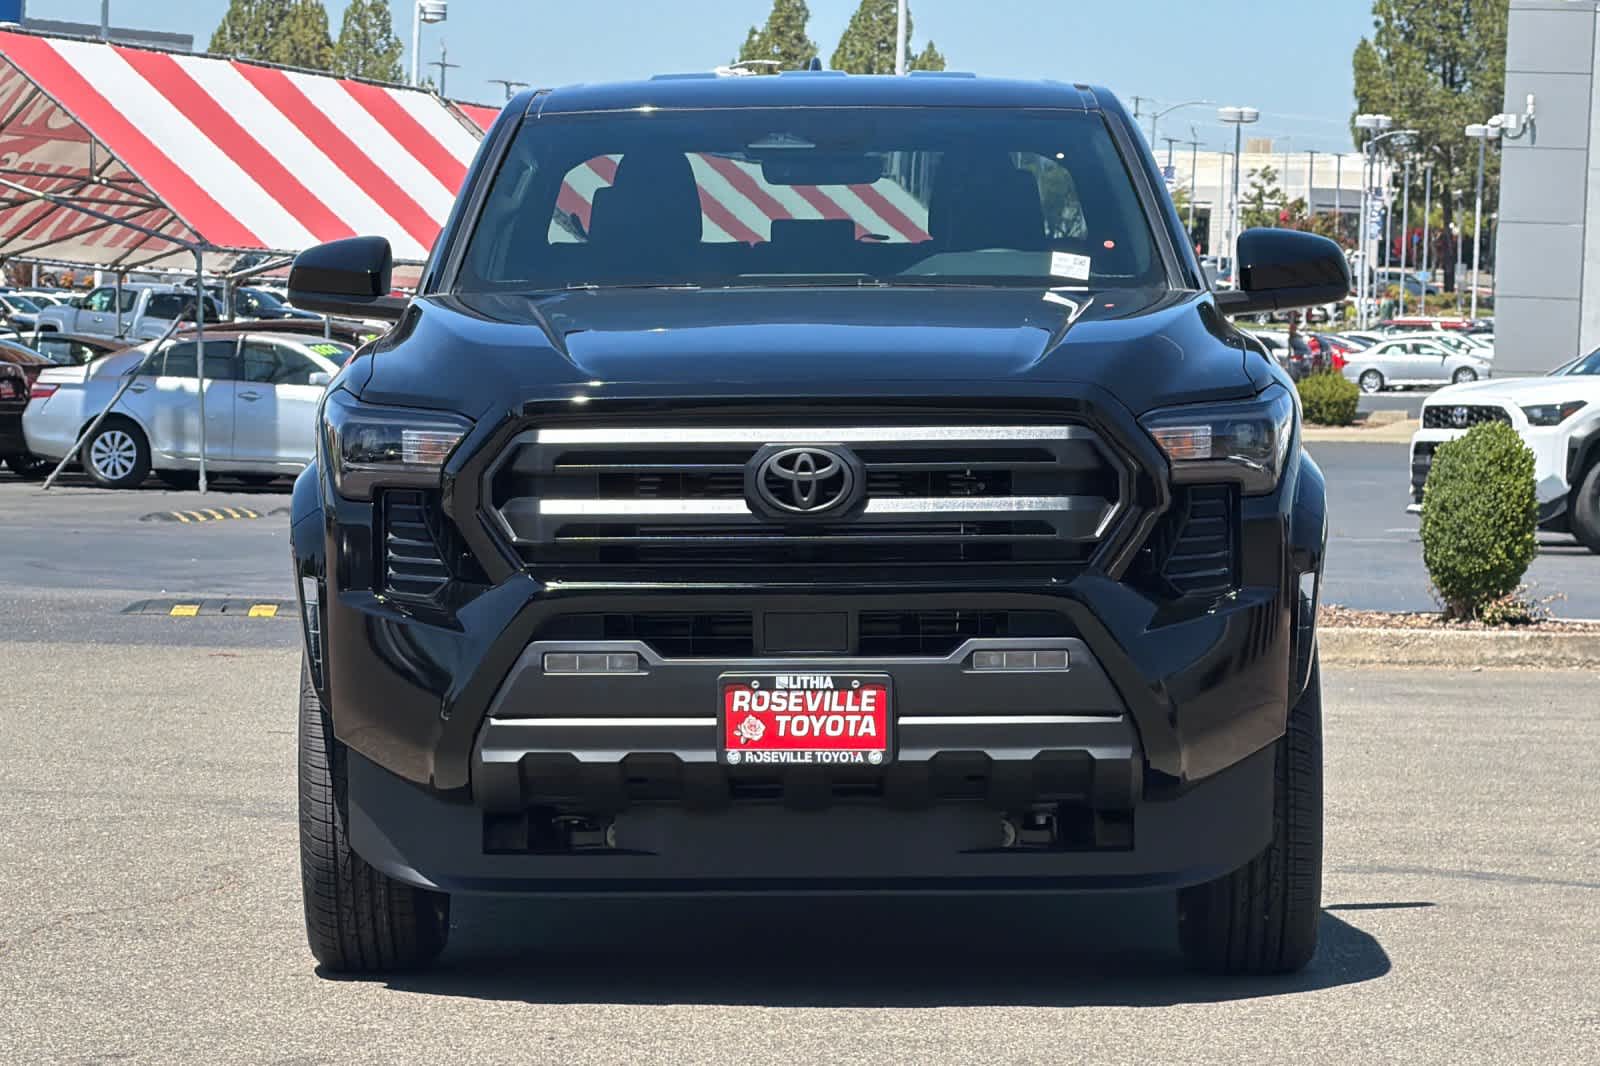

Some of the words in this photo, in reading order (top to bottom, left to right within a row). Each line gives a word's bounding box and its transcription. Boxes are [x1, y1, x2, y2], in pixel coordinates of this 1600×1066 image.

[788, 676, 834, 689] LITHIA
[732, 690, 876, 712] ROSEVILLE
[775, 715, 876, 737] TOYOTA
[745, 751, 812, 763] ROSEVILLE
[815, 751, 864, 763] TOYOTA
